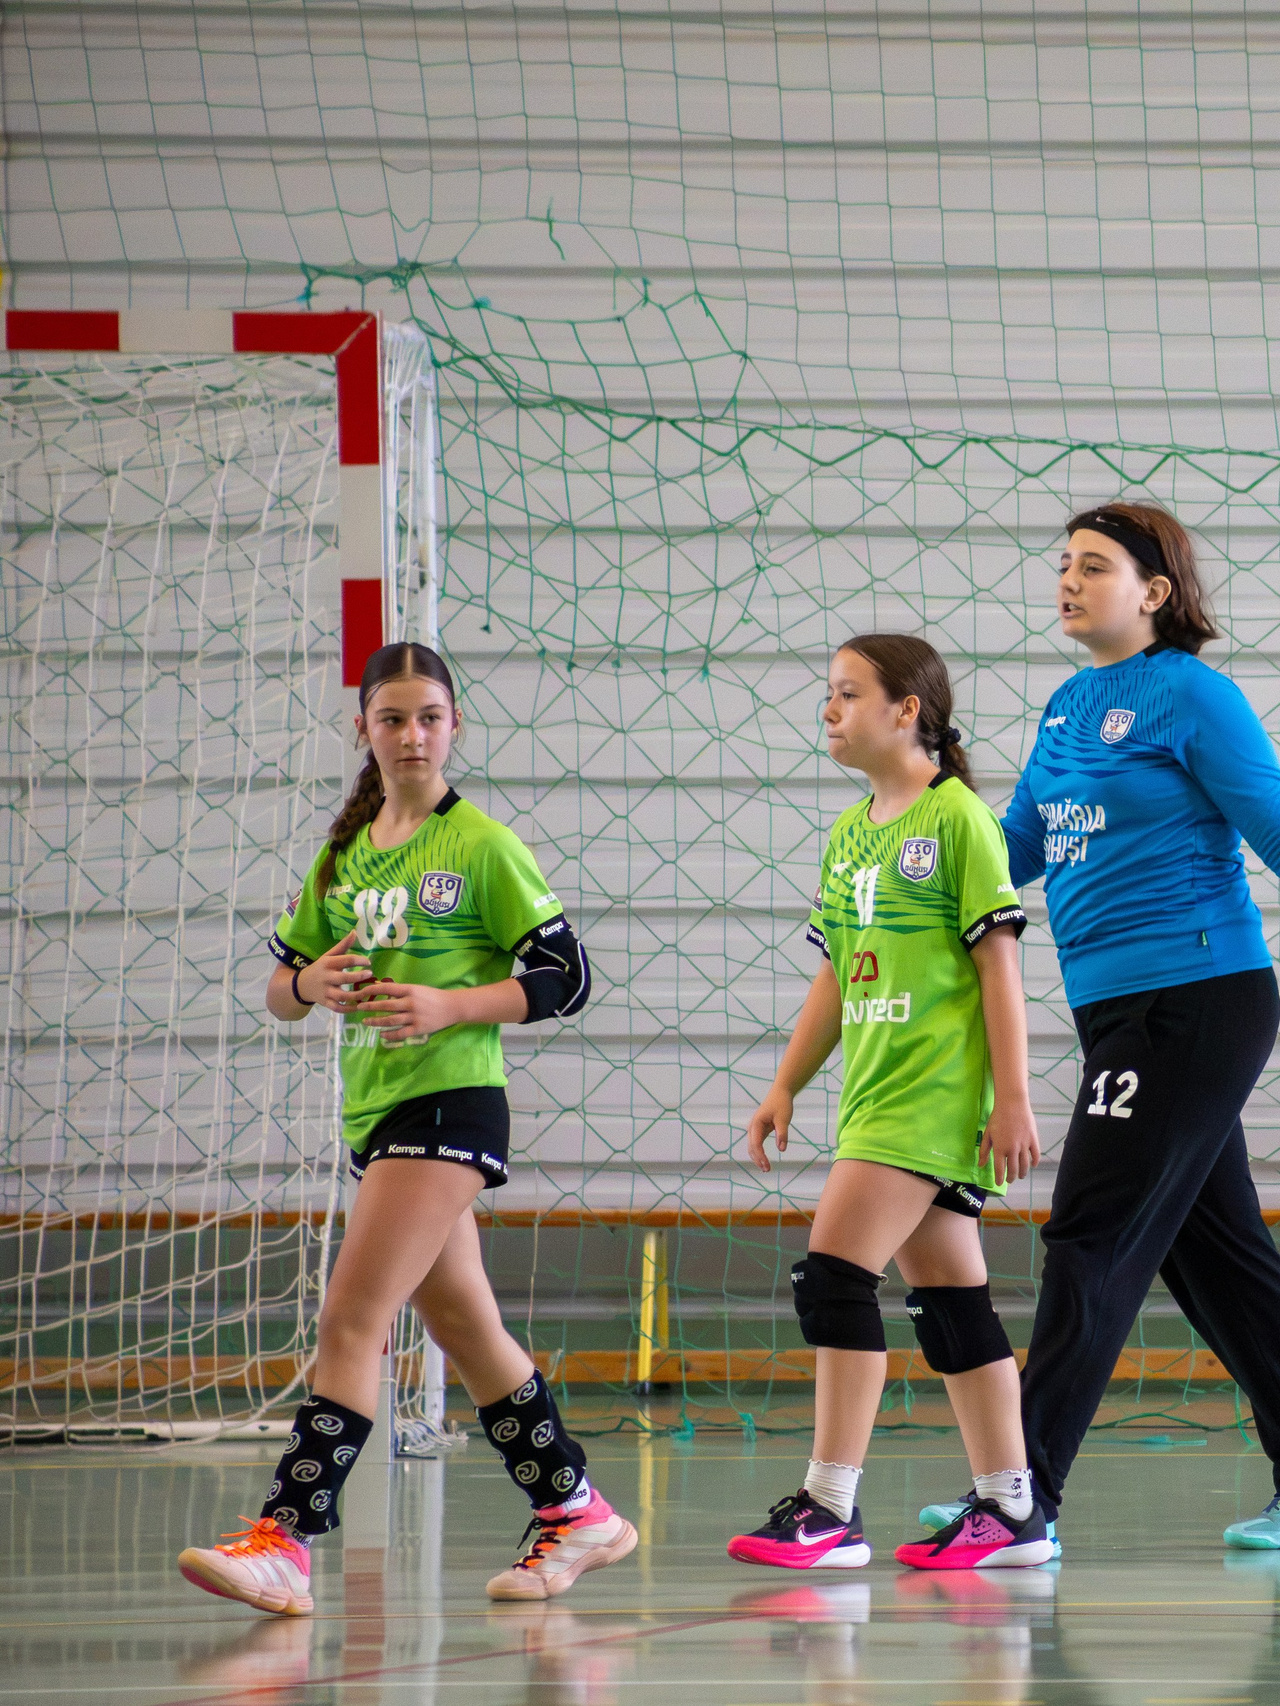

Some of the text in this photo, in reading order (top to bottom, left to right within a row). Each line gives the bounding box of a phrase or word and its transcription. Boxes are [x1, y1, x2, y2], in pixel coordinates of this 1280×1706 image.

[1109, 714, 1129, 724] CSO
[908, 845, 932, 855] CSO
[427, 877, 456, 890] CSO
[850, 864, 882, 928] 11
[354, 886, 409, 950] 88
[539, 921, 564, 938] Kempa
[965, 923, 986, 943] Kempa
[1087, 1070, 1139, 1118] 12
[388, 1144, 426, 1156] Kempa
[438, 1145, 473, 1161] Kempa
[481, 1152, 503, 1170] Kempa
[956, 1184, 983, 1209] Kempa
